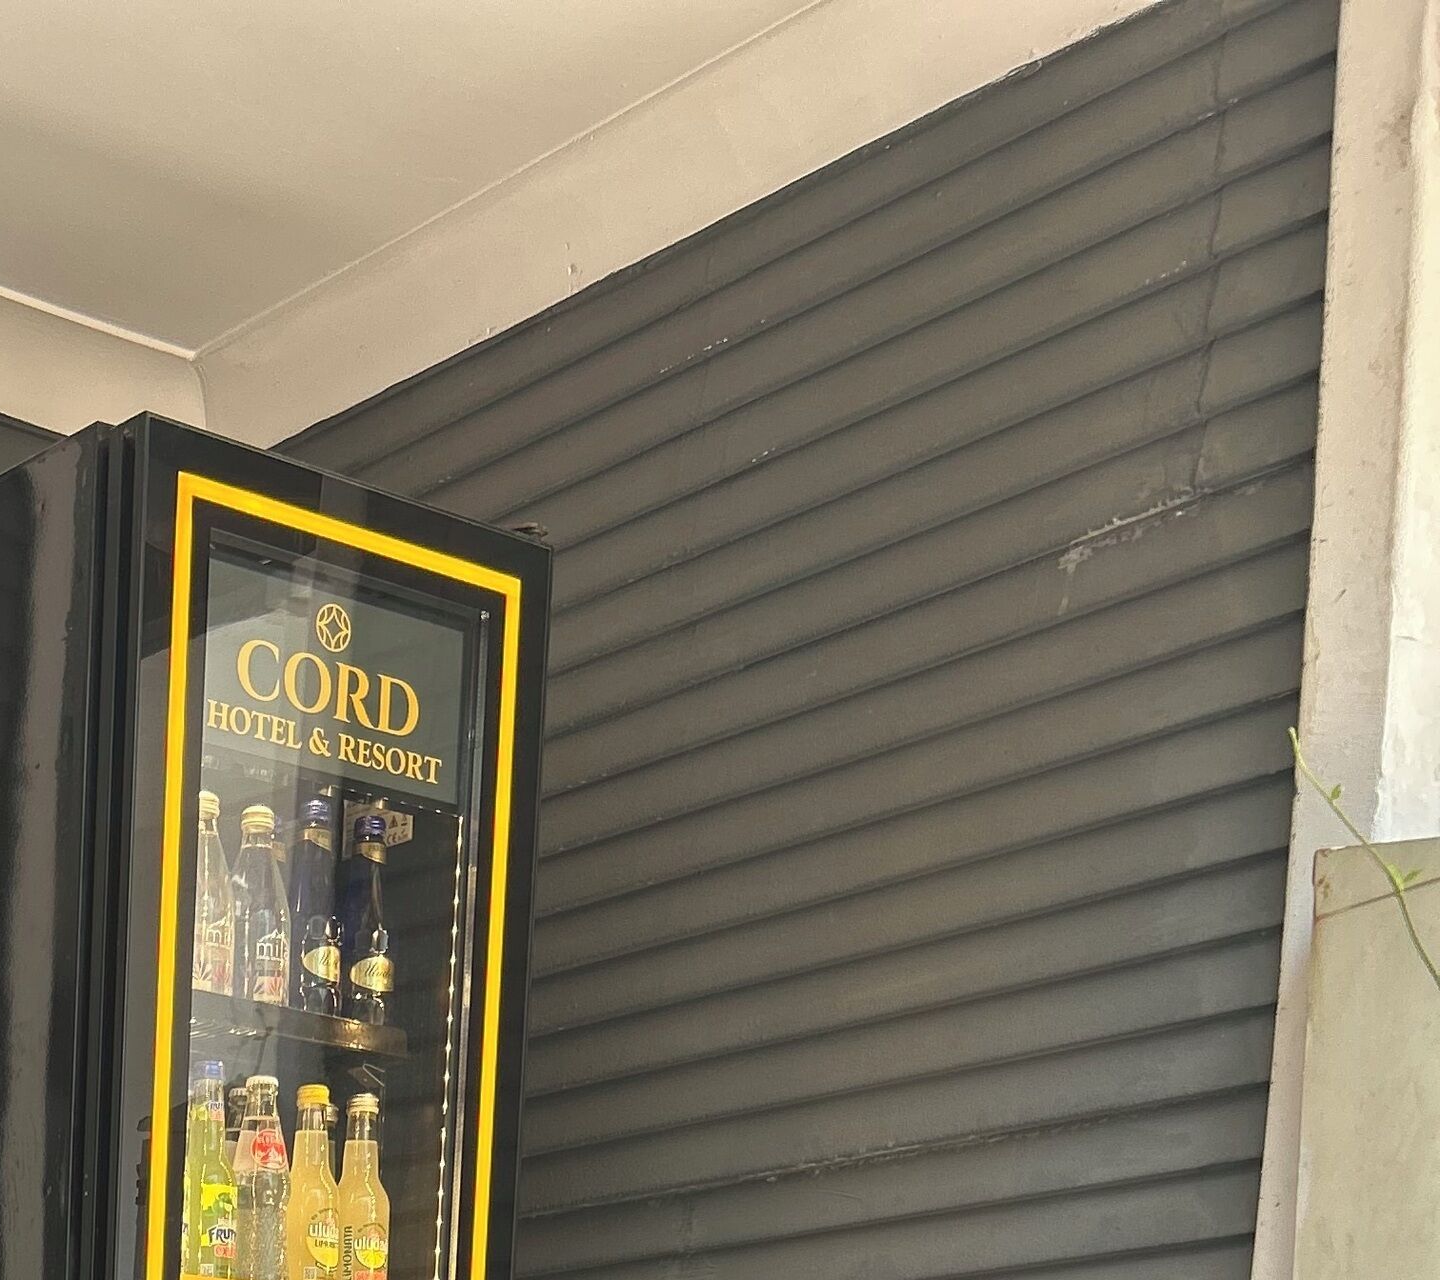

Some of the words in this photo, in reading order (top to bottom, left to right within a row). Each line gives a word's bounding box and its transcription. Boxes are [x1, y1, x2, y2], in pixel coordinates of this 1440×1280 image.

[236, 638, 420, 737] CORD
[207, 698, 303, 750] HOTEL
[309, 726, 331, 758] &
[338, 732, 443, 785] RESORT
